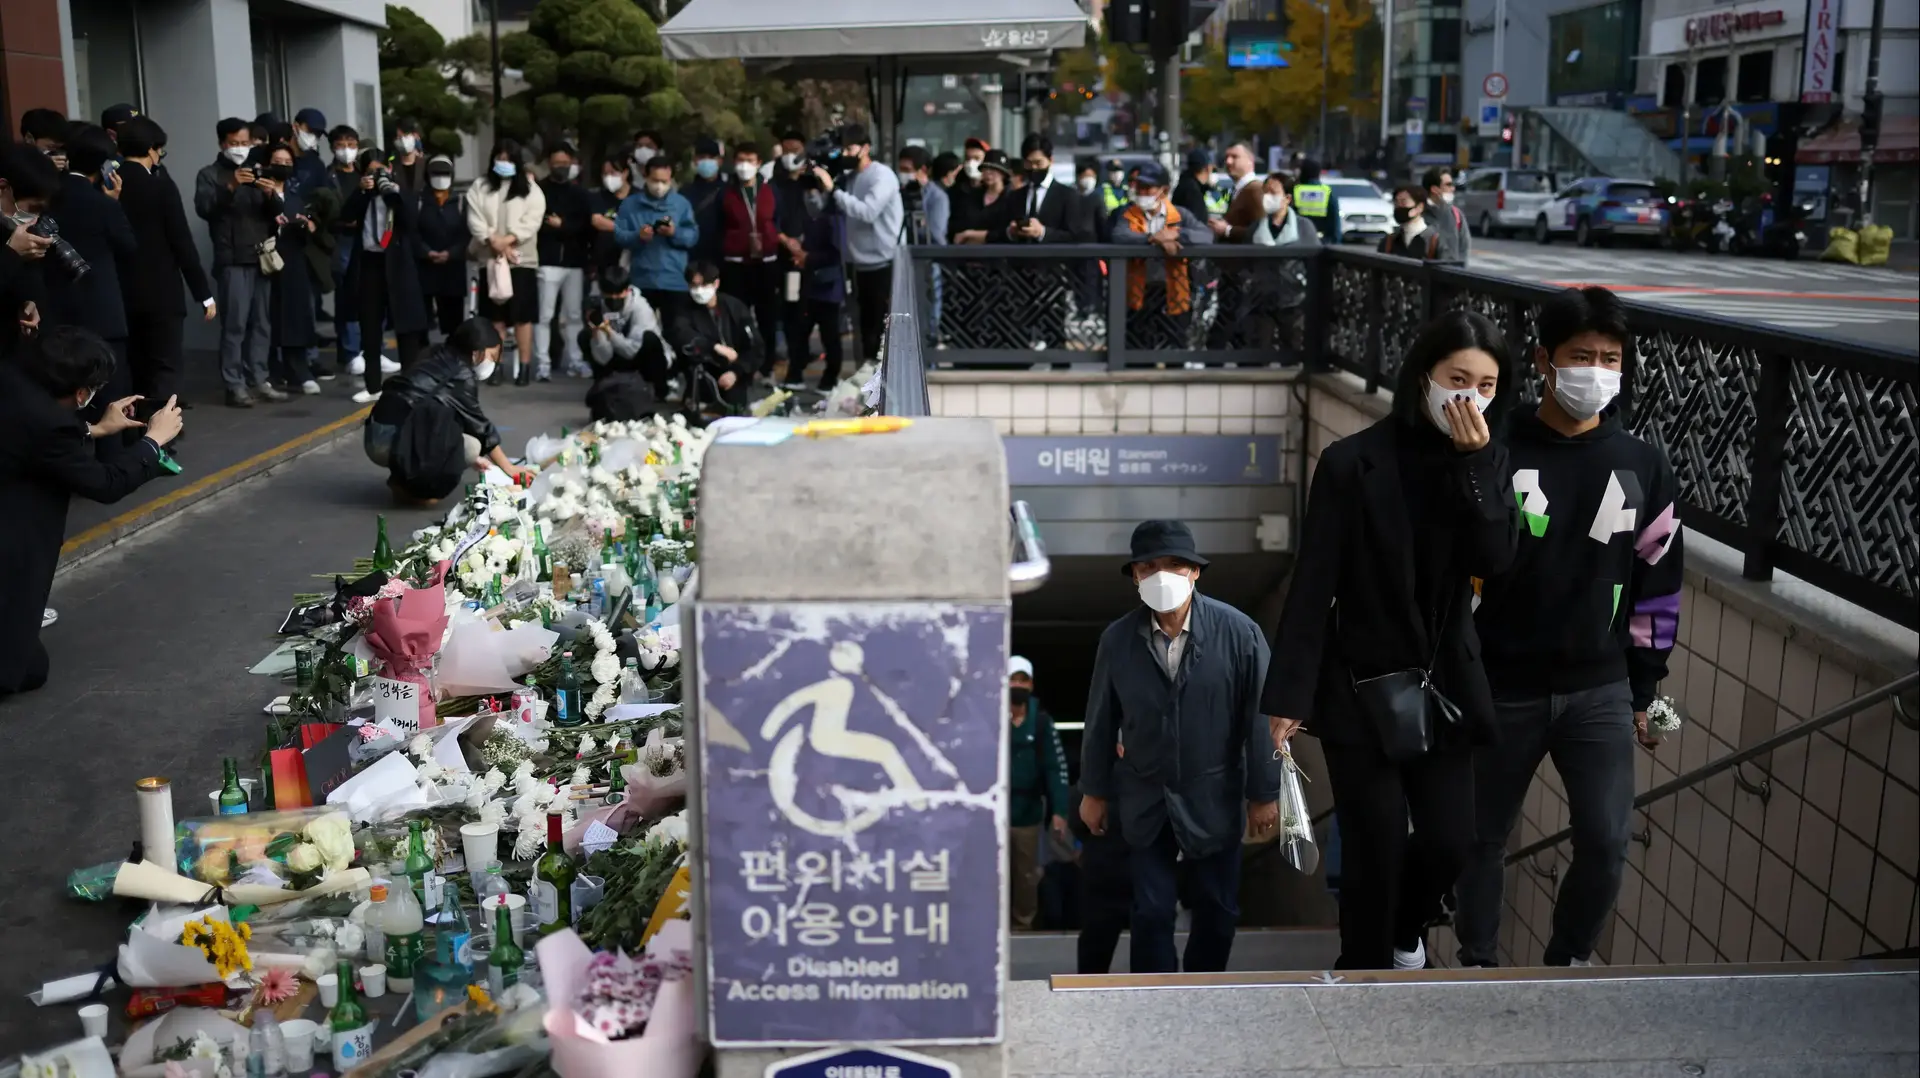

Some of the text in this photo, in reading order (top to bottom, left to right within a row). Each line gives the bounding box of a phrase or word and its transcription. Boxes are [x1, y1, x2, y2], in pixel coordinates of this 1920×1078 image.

[1038, 447, 1111, 476] 이태원
[1247, 442, 1257, 465] 1
[741, 902, 950, 946] 이용안내
[787, 957, 900, 978] Disabled
[727, 980, 969, 1001] Access Information
